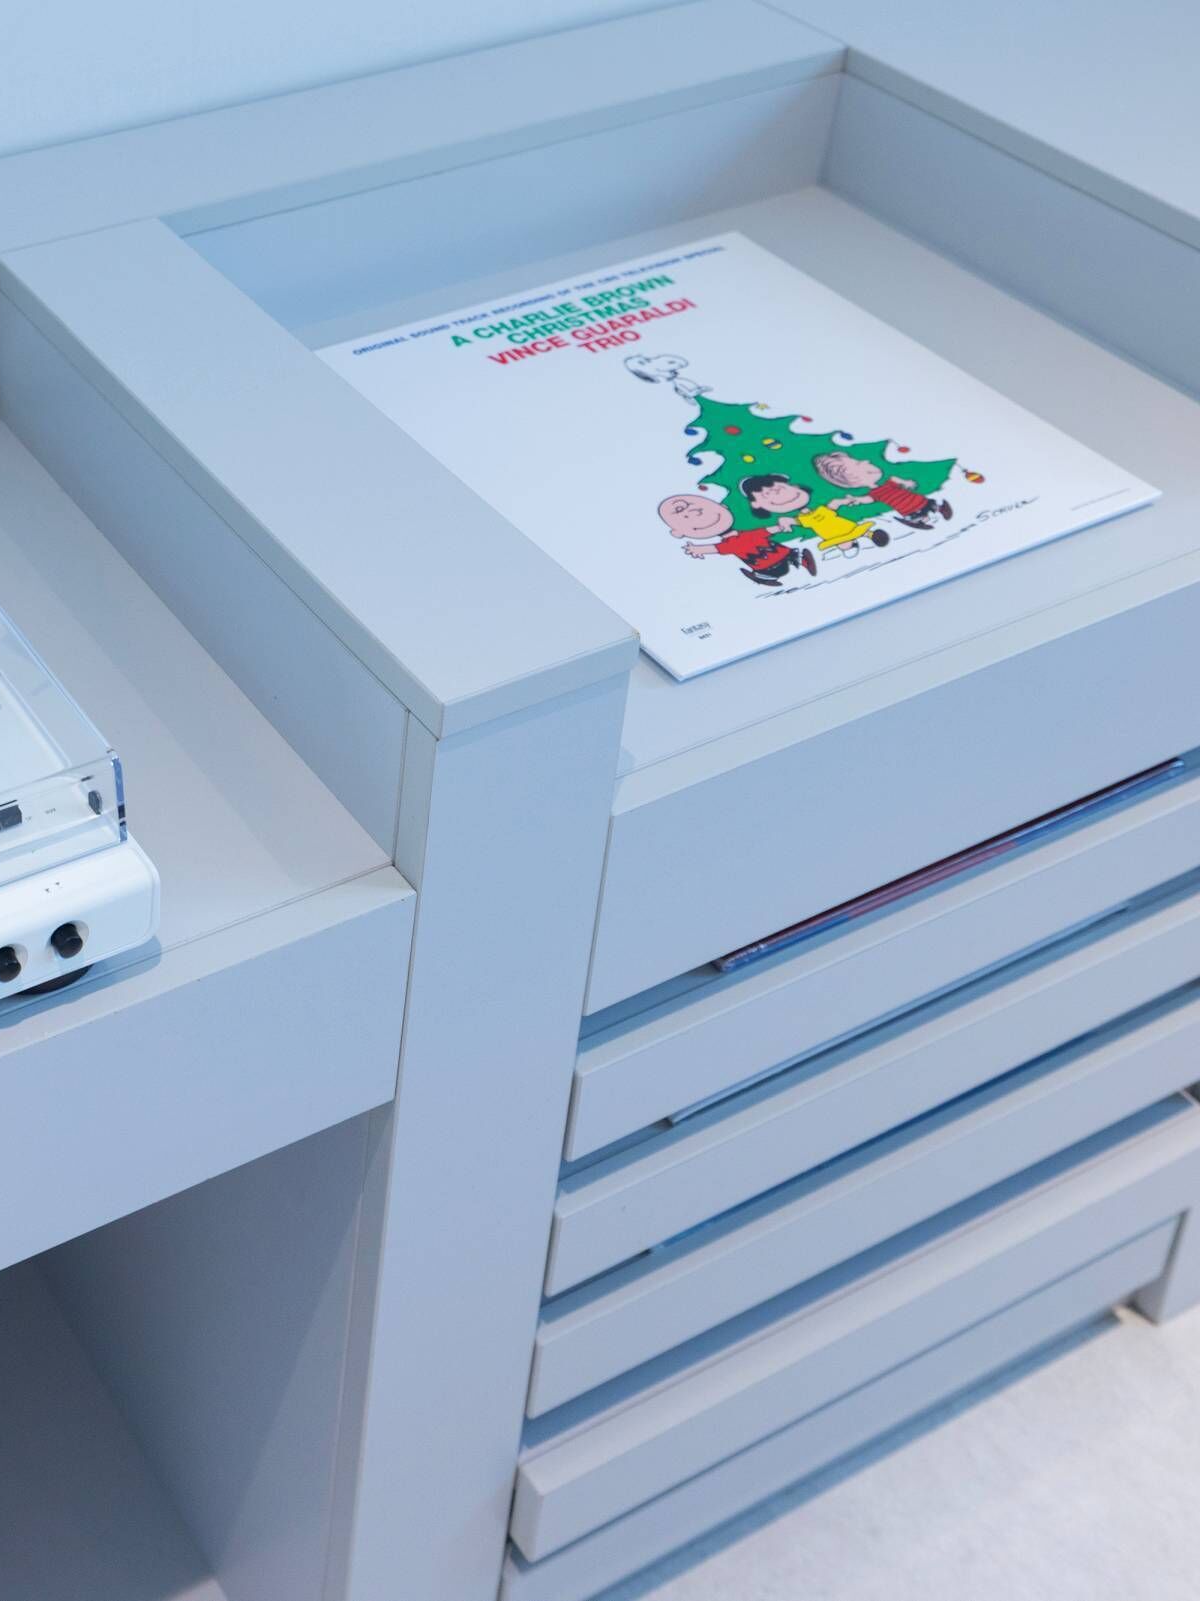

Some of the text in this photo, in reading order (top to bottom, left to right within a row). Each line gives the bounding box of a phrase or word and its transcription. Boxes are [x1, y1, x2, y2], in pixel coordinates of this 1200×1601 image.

[450, 275, 676, 348] A CHARLIE BROWN
[451, 313, 489, 326] TRACK
[488, 298, 698, 365] VINCE GUARALDI
[507, 298, 652, 344] CHRISTMAS
[577, 329, 642, 354] TRIO
